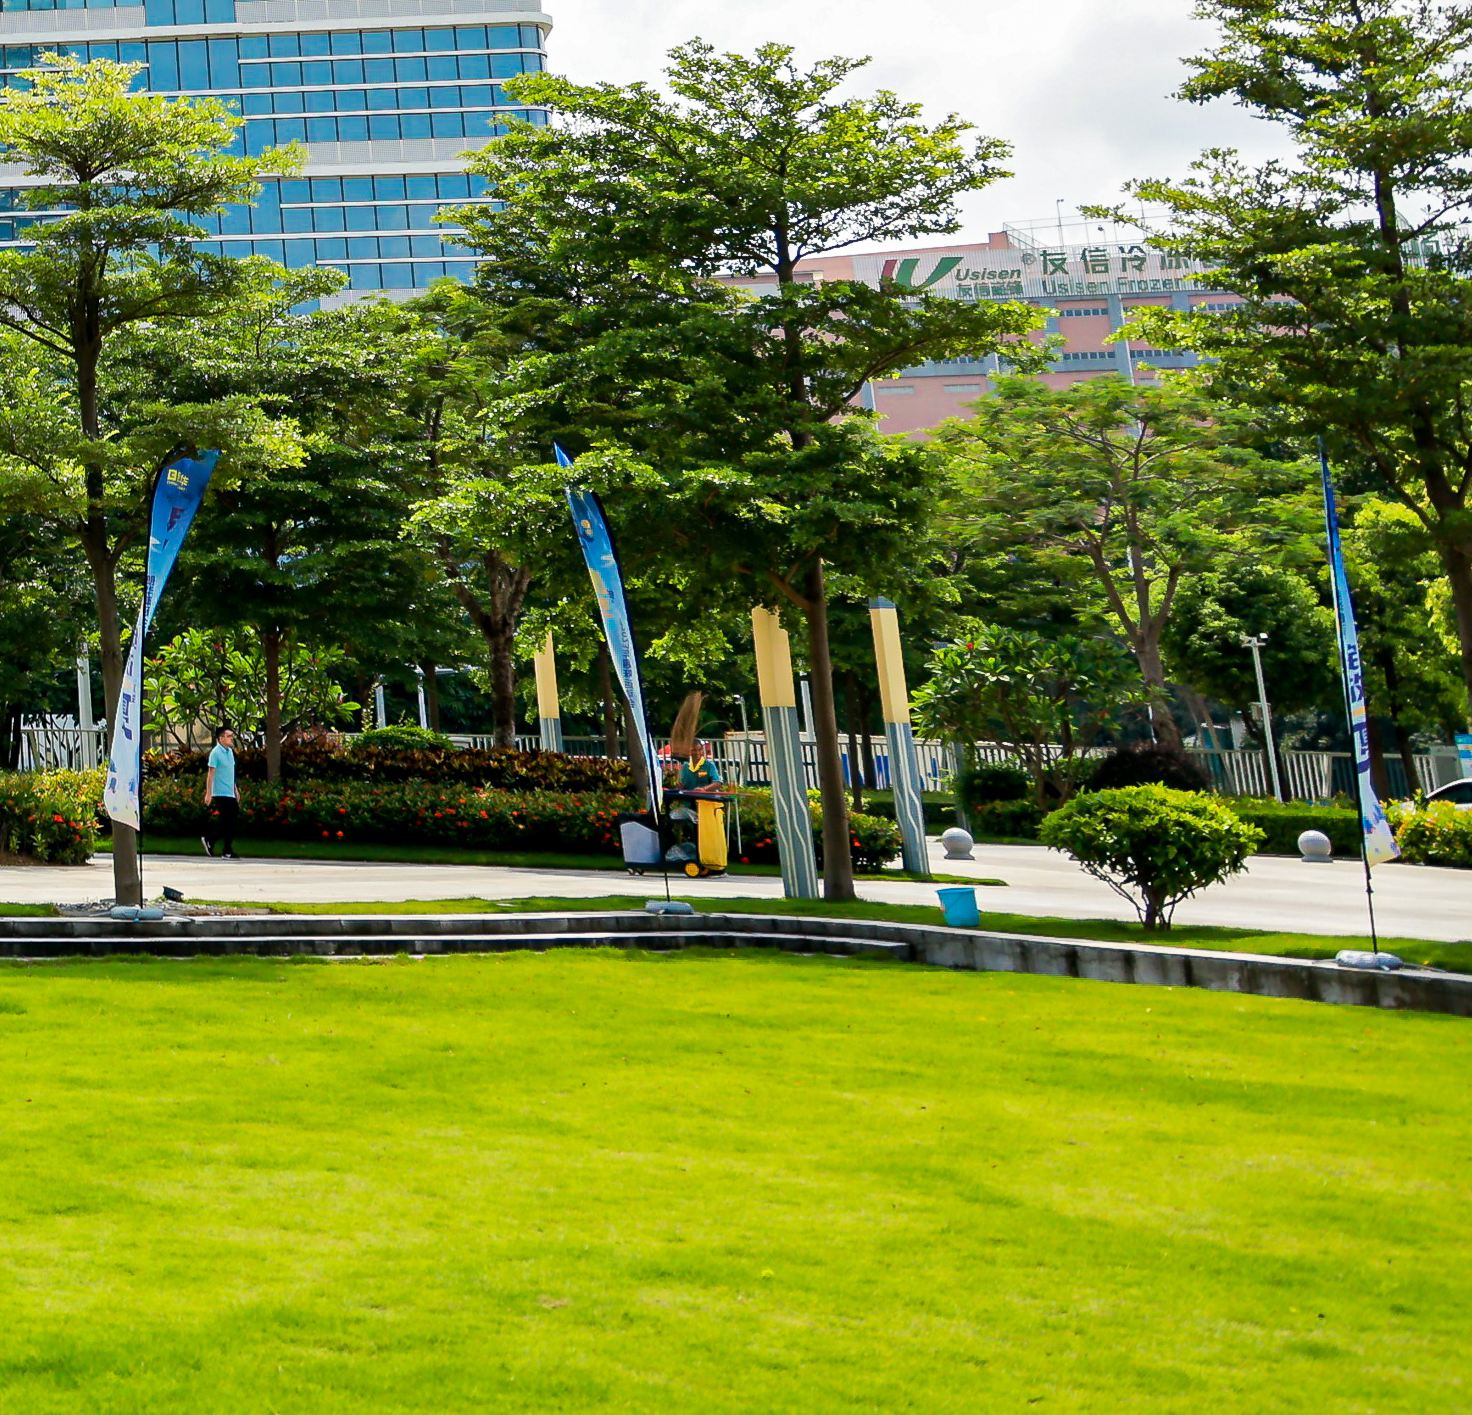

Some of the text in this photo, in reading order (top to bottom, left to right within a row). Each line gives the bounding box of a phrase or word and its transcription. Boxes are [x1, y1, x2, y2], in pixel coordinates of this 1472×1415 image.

[955, 267, 1022, 282] Usisen
[1043, 279, 1108, 295] Usisen
[1117, 276, 1182, 292] Frozen
